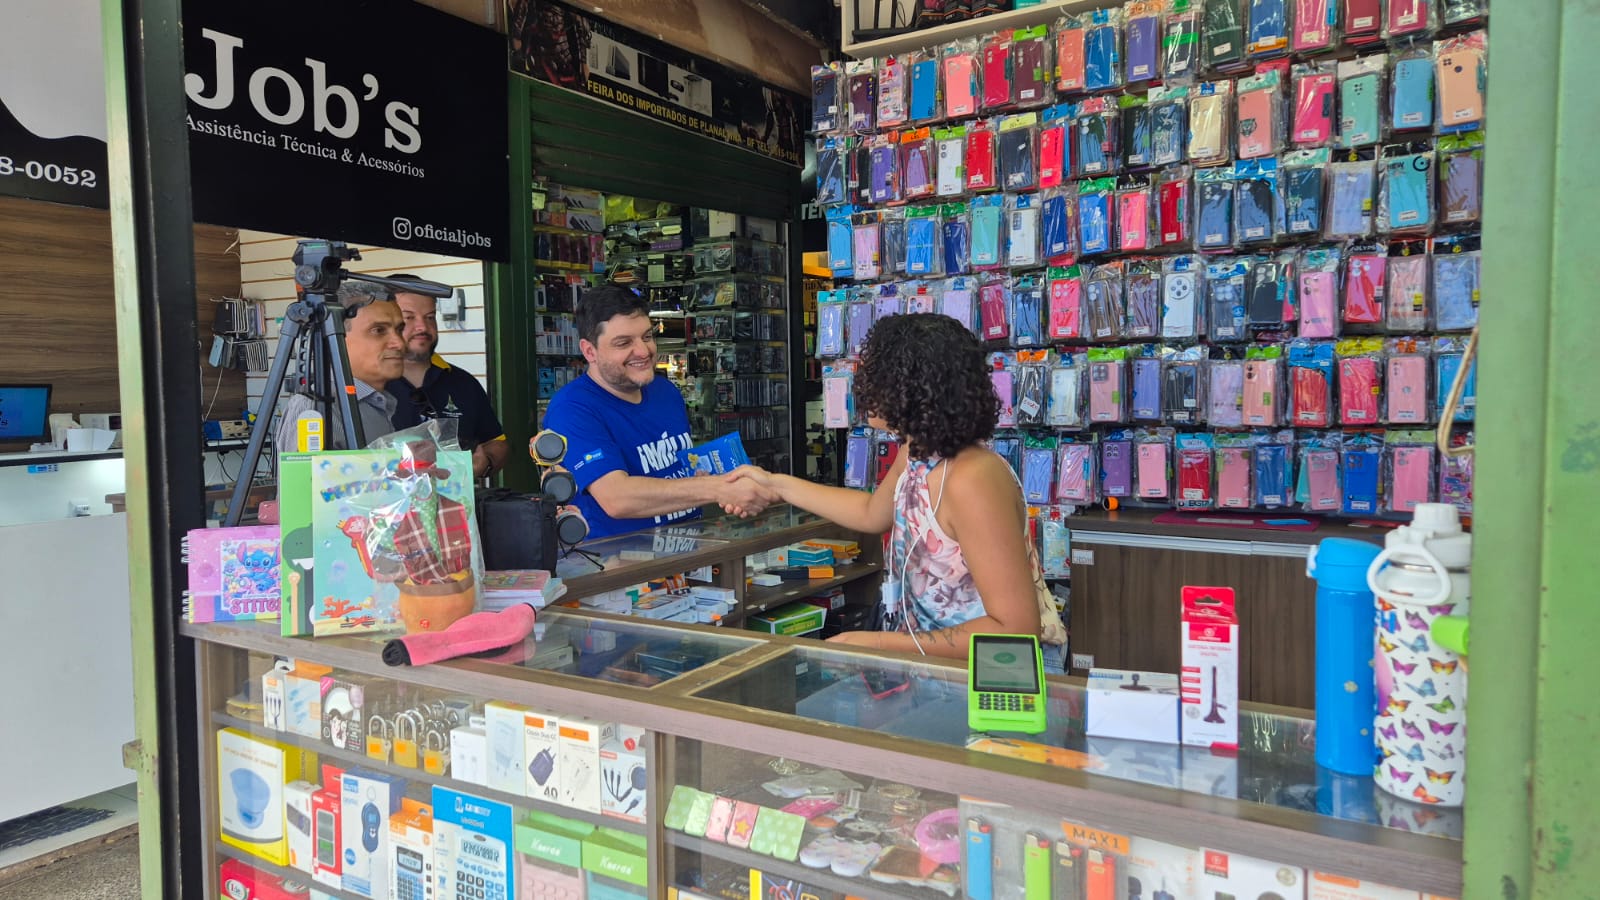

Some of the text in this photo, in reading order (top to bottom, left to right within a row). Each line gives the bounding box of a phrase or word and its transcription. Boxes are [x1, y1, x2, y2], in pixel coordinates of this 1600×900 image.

[184, 27, 422, 154] Job's
[587, 79, 614, 100] FEIRA
[616, 90, 634, 107] DOS
[636, 96, 687, 126] IMPORTADOS
[689, 116, 699, 129] DE
[185, 113, 425, 178] Assistência Técnica & Acessórios
[414, 223, 492, 248] oficialjobs
[543, 785, 559, 800] 40
